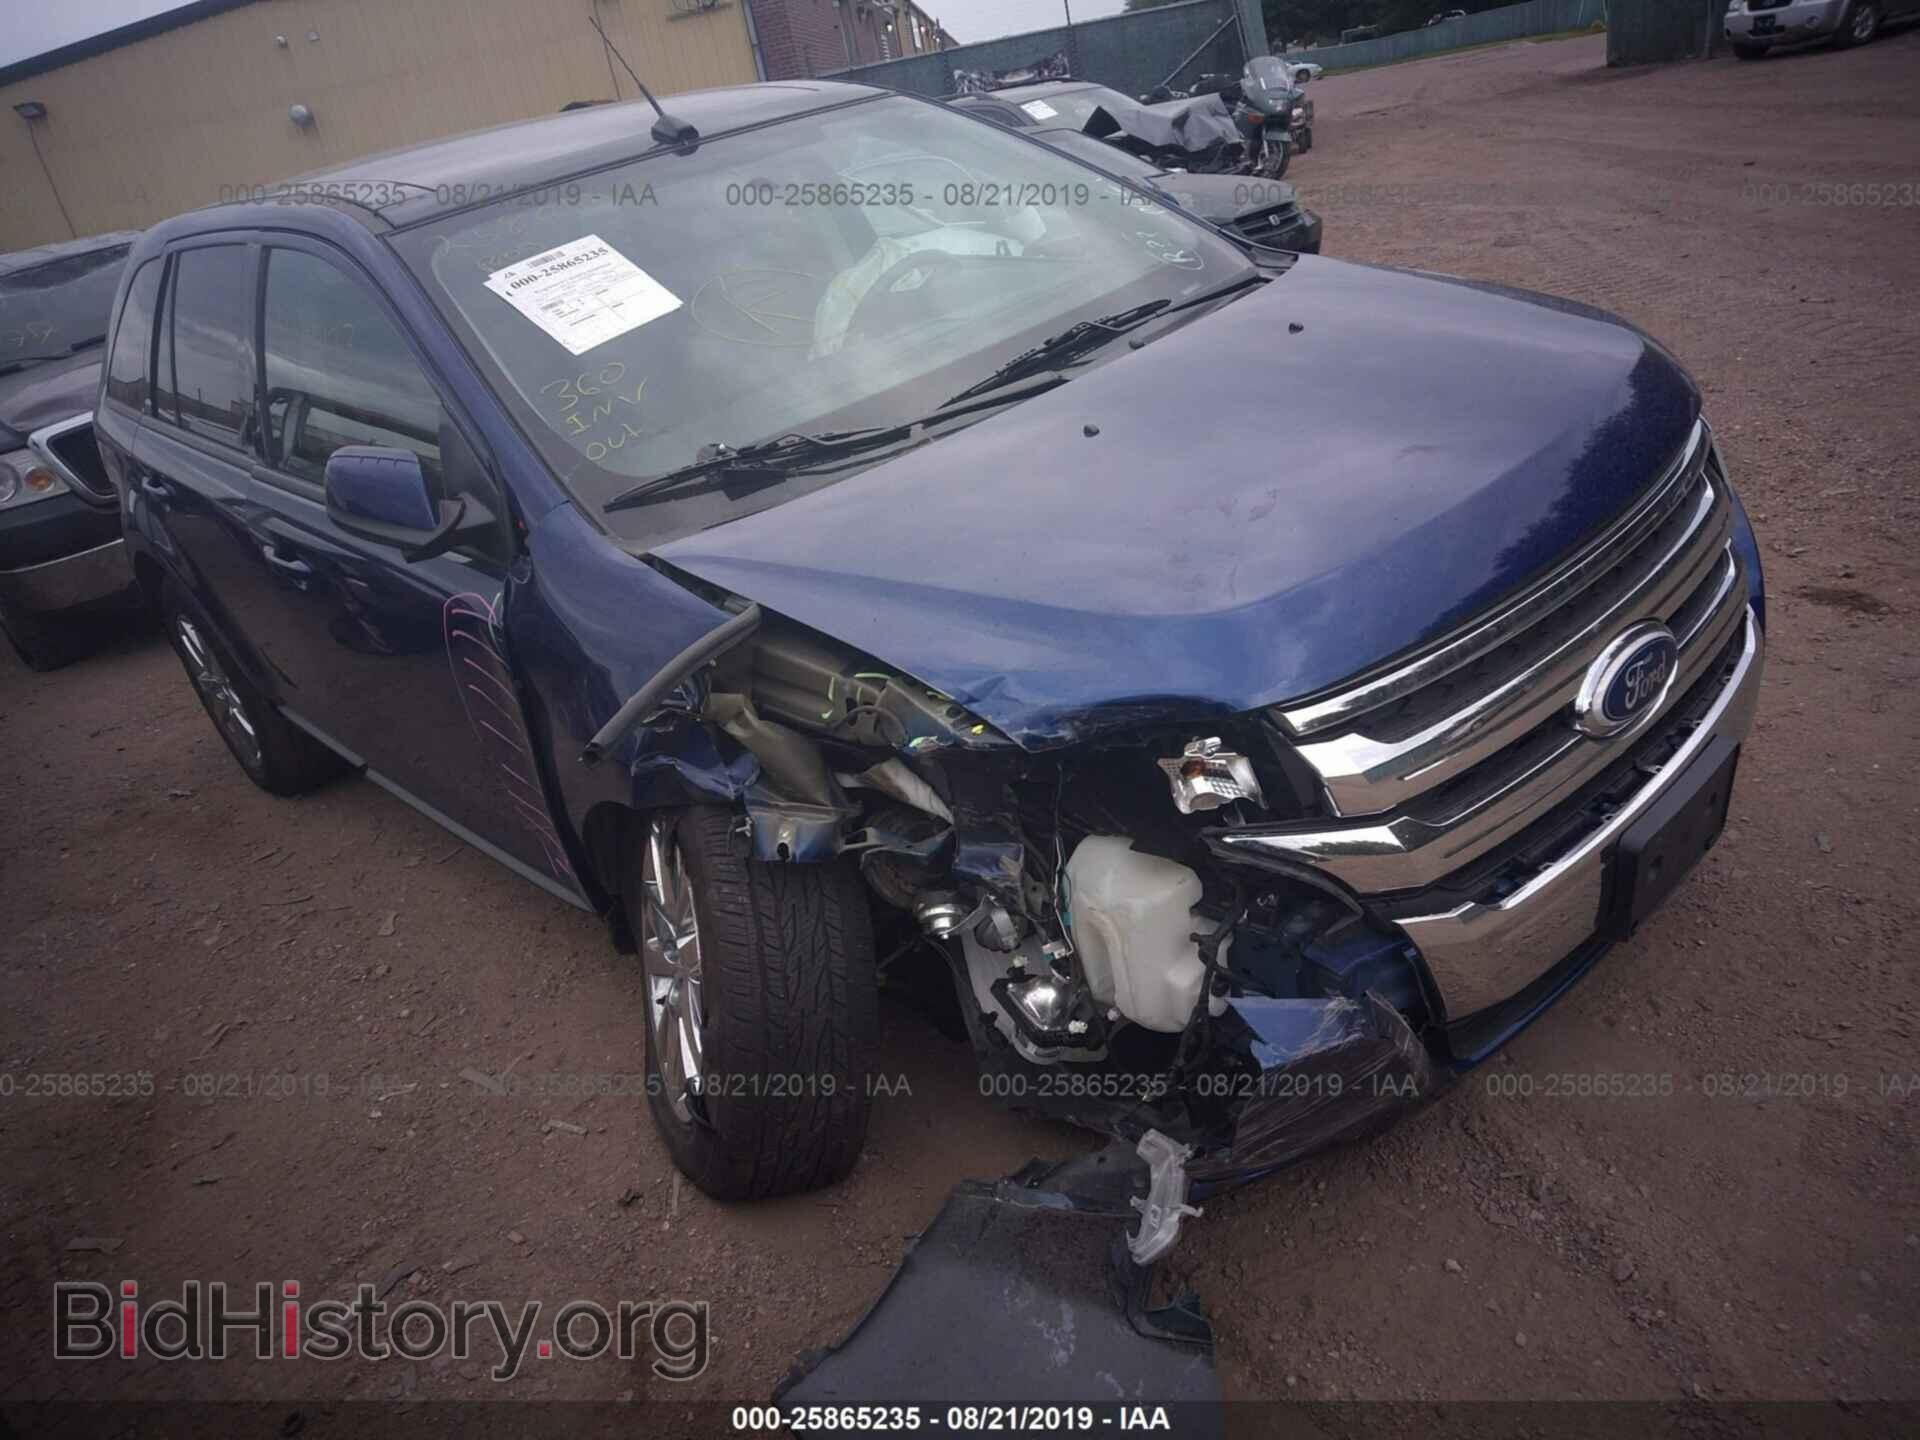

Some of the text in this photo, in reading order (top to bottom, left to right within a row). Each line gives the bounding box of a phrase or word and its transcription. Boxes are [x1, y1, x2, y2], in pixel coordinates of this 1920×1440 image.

[509, 246, 610, 290] 000-25865235
[540, 362, 625, 412] 360
[1625, 651, 1666, 709] Ford
